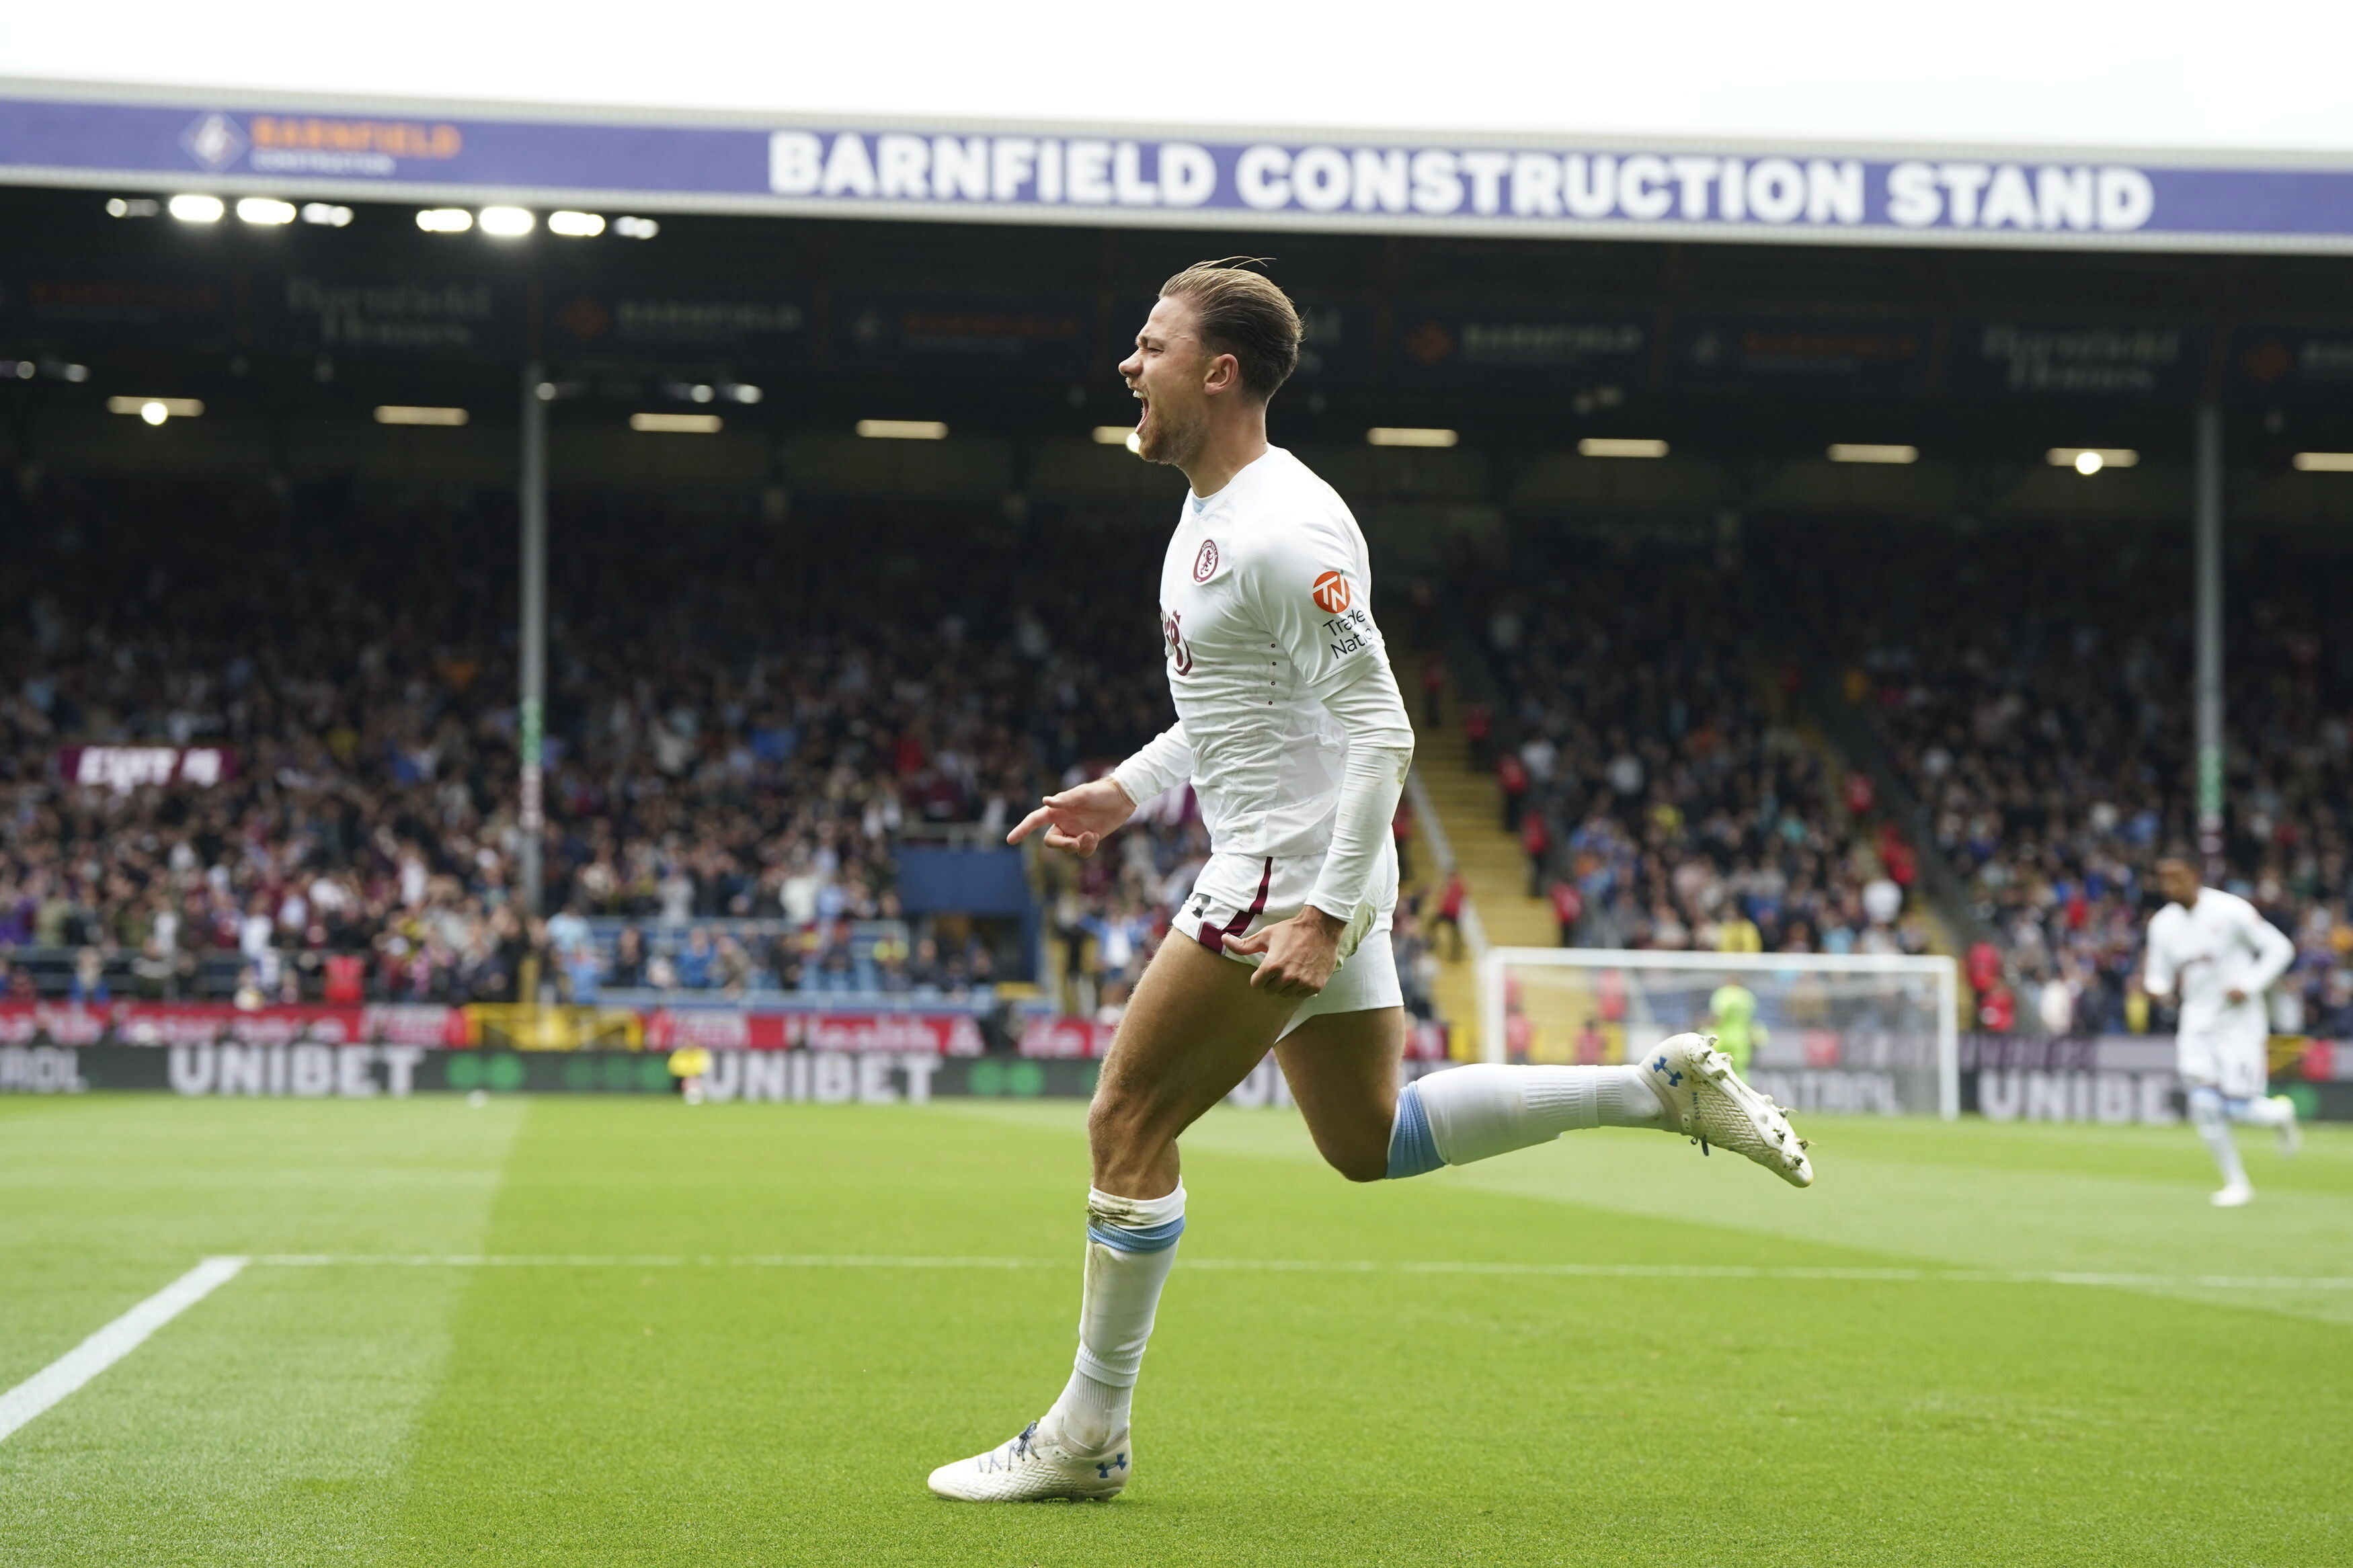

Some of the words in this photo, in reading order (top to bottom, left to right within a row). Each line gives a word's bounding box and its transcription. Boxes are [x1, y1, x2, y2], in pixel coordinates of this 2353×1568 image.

[251, 118, 461, 157] BARNFIELD
[768, 130, 1217, 207] BARNFIELD
[1236, 144, 1865, 224] CONSTRUCTION
[1886, 162, 2154, 230] STAND
[1322, 609, 1366, 636] Trade
[1330, 628, 1373, 659] Natio
[170, 1045, 424, 1096] UNIBET
[705, 1052, 942, 1105] UNIBET
[1979, 1070, 2182, 1124] UNIBE
